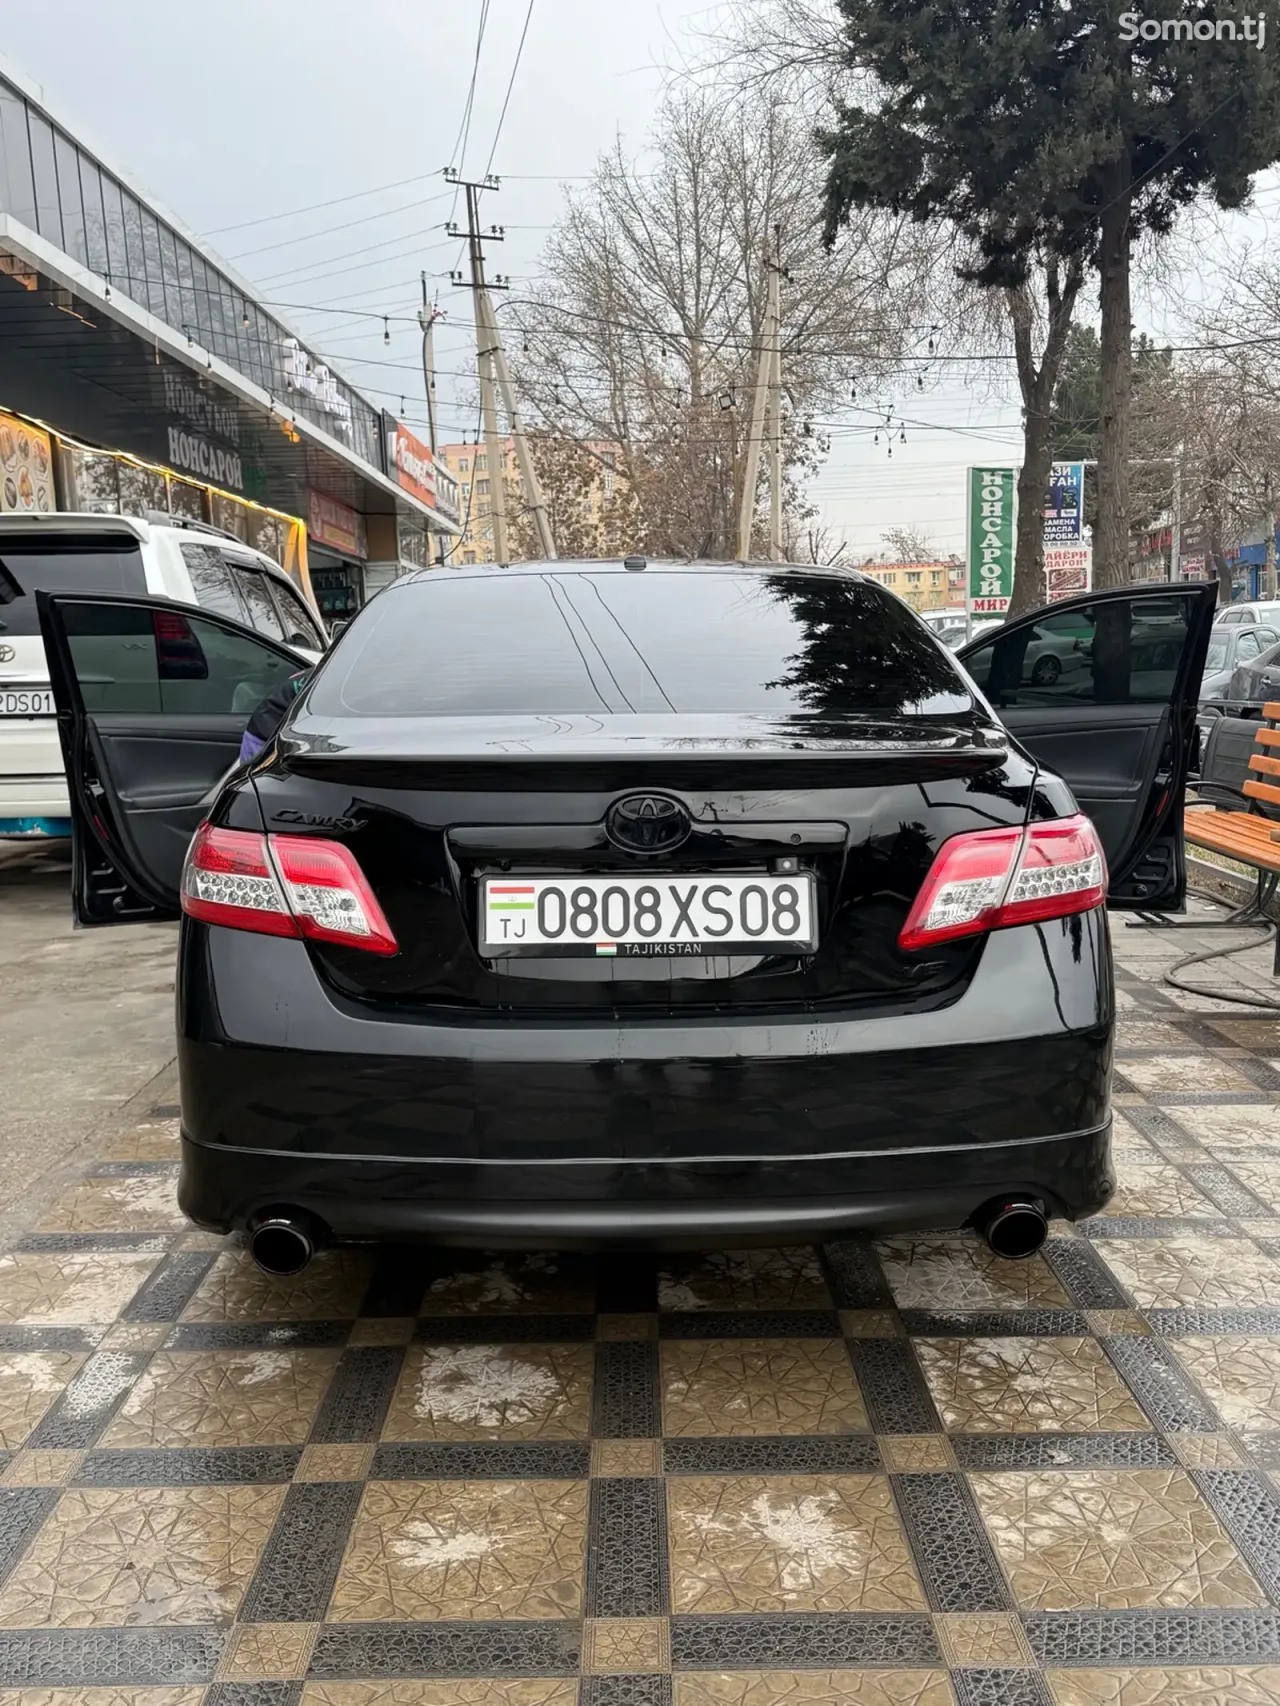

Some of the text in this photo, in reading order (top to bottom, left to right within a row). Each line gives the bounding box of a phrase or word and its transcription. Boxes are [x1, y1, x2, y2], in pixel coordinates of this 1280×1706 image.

[168, 426, 243, 490] НОНСАРОЙ
[979, 471, 1004, 596] НОНСАРОЙ
[1046, 550, 1087, 560] АЙЁРИ
[500, 918, 526, 939] TJ
[537, 884, 801, 939] 0808XS08
[624, 942, 702, 955] TAJIKISTAN
